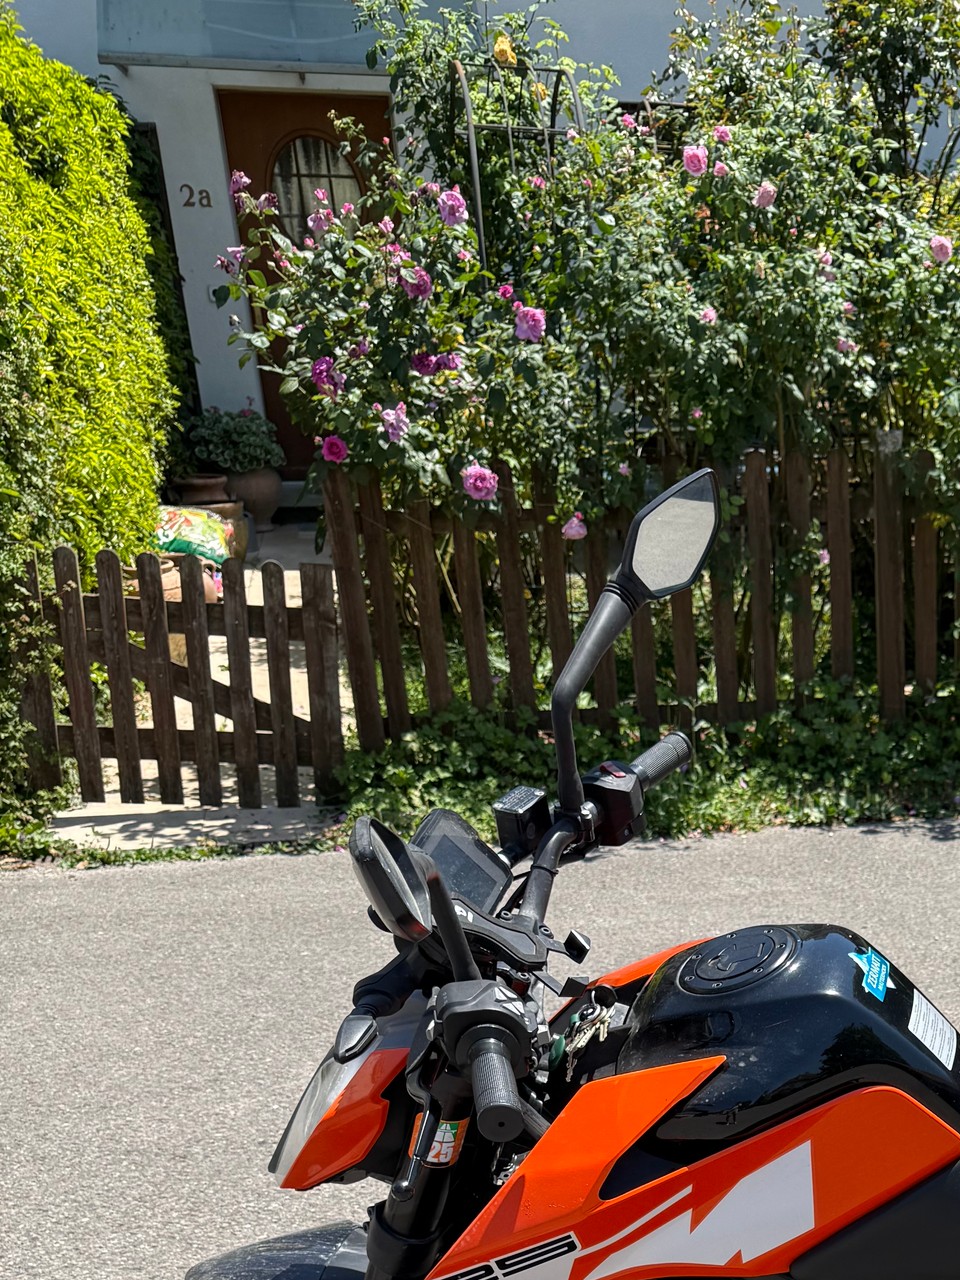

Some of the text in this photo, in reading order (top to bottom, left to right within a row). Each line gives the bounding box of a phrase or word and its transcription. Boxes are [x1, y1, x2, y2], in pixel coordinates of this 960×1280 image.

[179, 183, 213, 208] 2a
[868, 954, 881, 989] ZERMATT
[427, 1141, 456, 1163] 25
